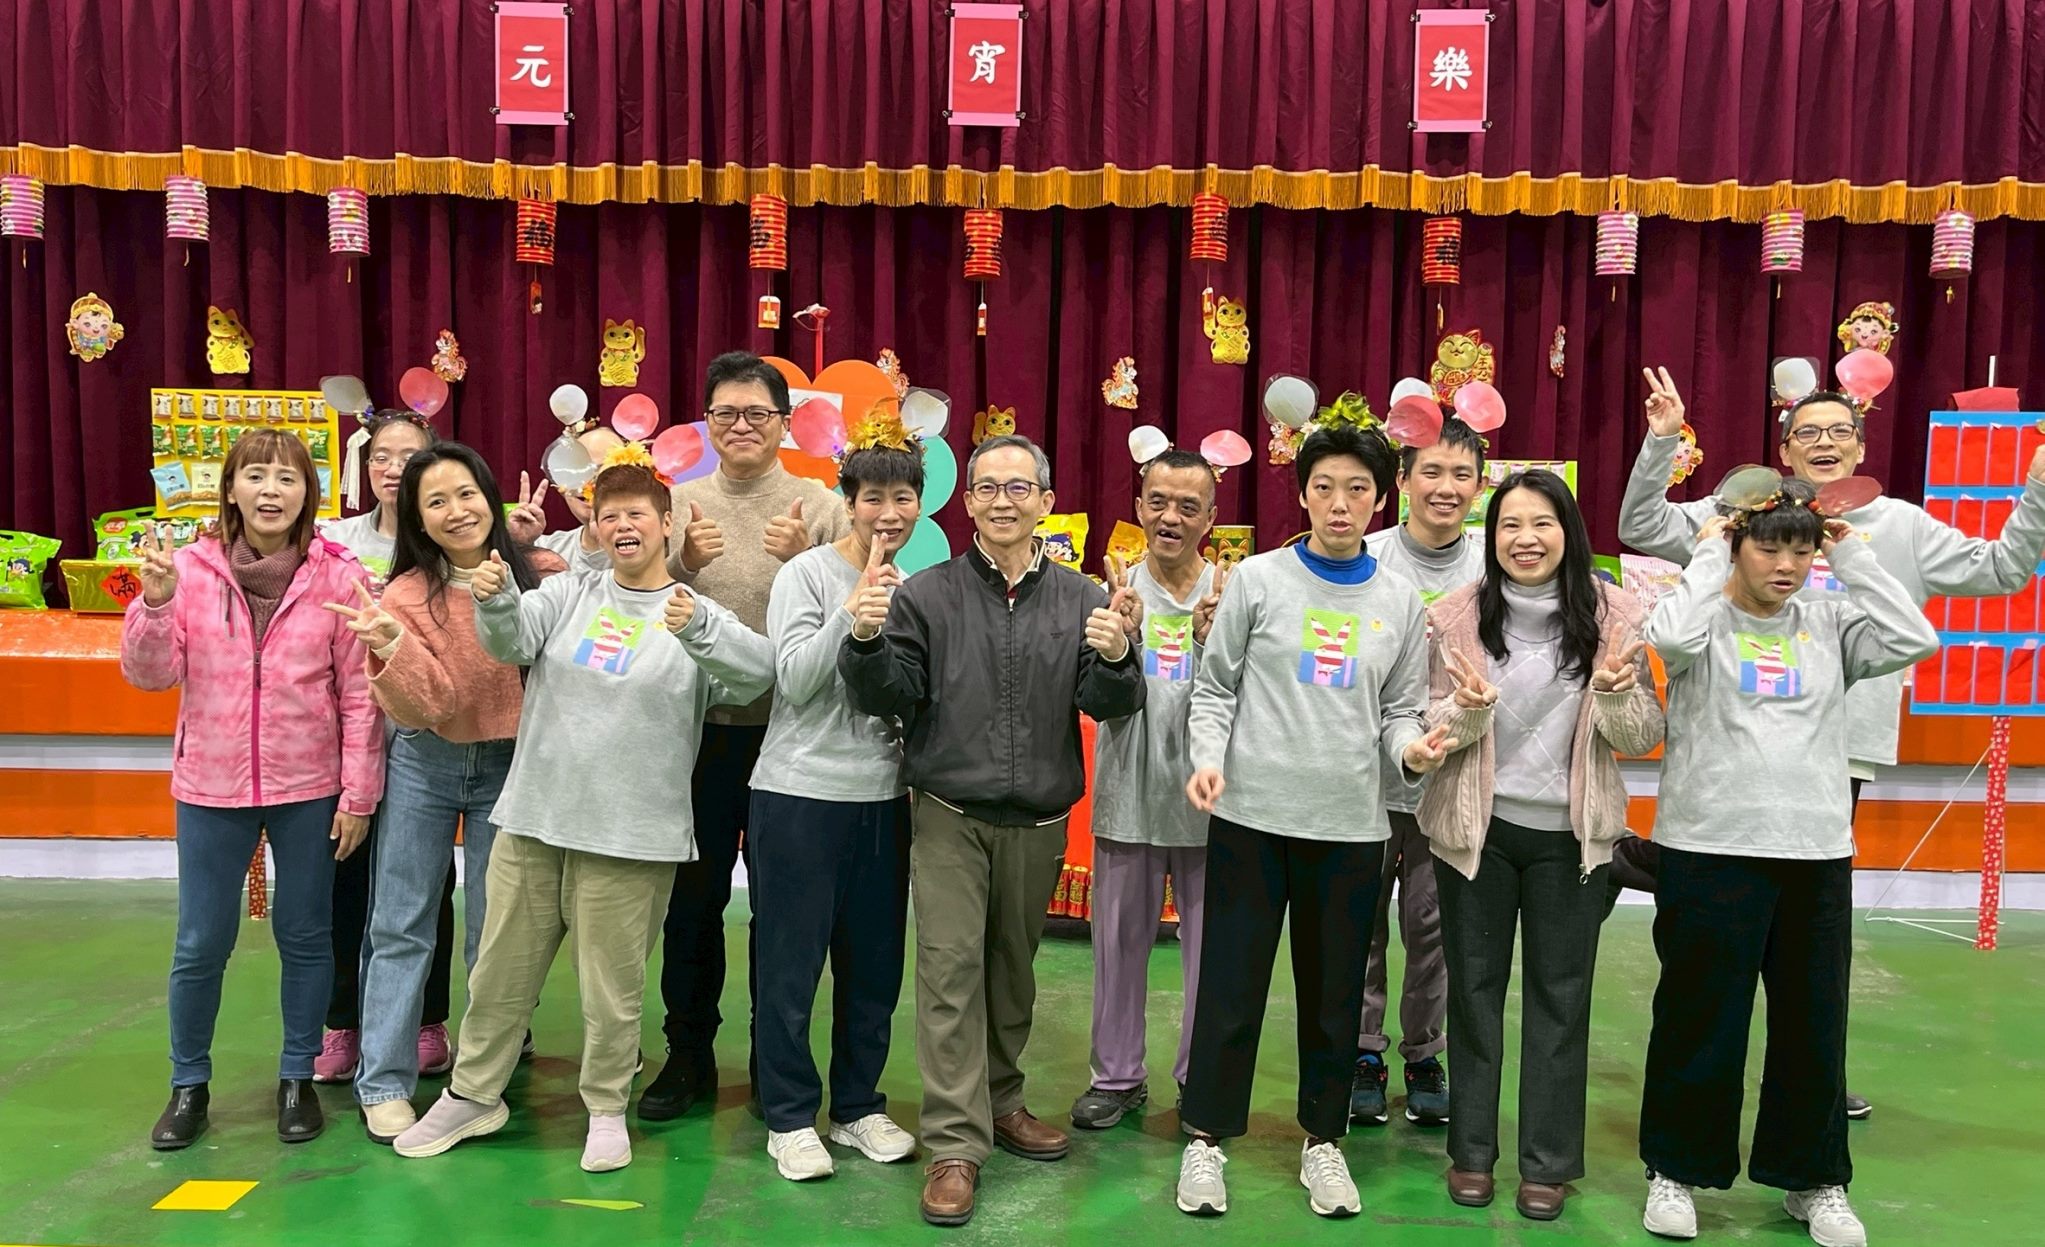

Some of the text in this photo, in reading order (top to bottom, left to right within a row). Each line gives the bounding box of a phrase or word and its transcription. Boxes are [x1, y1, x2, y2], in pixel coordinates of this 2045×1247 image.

[509, 44, 552, 88] 元
[967, 39, 1006, 85] 宵
[1428, 46, 1473, 92] 樂
